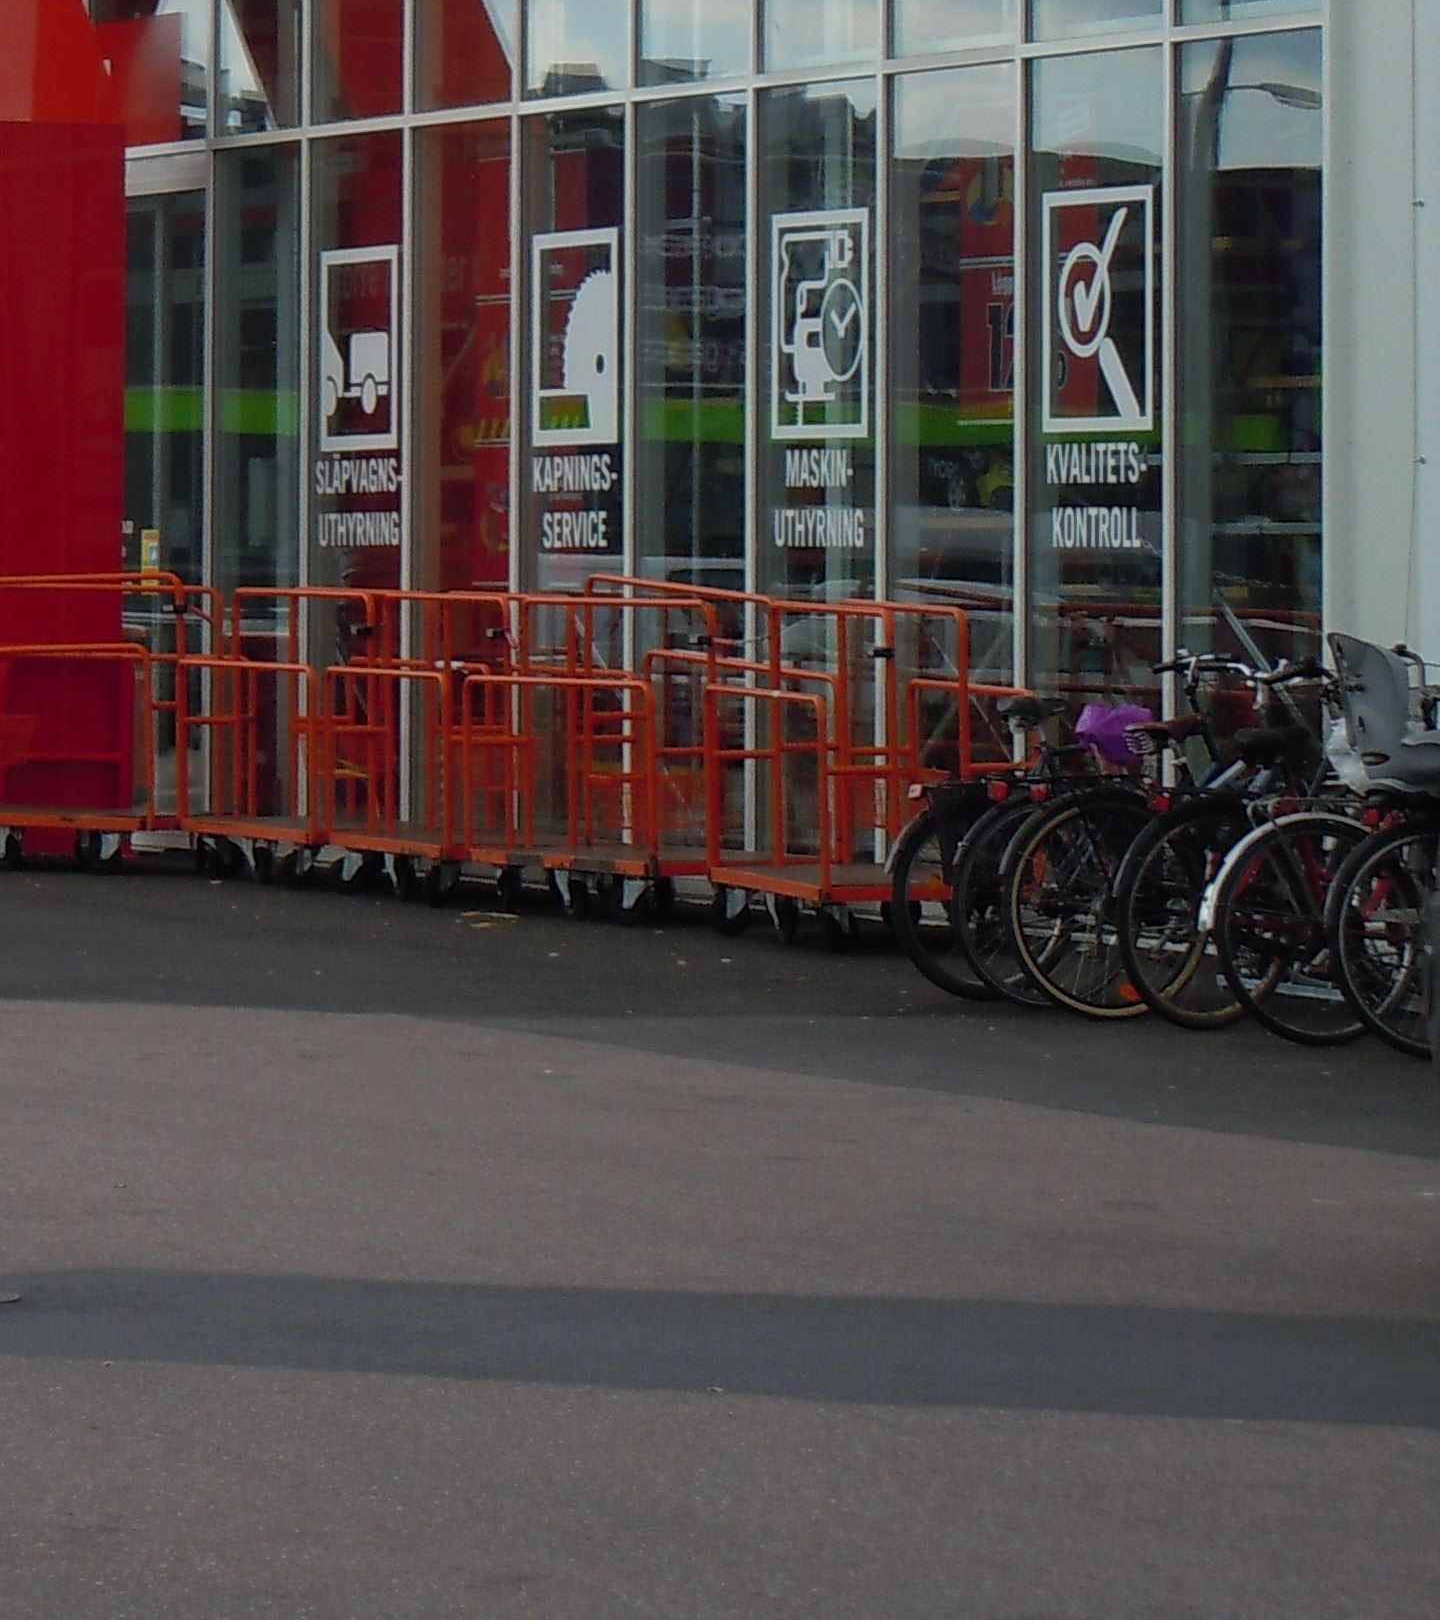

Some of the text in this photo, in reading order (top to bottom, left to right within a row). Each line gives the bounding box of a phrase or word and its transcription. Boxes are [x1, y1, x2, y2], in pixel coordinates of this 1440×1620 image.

[532, 454, 618, 493] KAPNINGS-
[785, 451, 854, 489] MASKIN-
[1046, 442, 1147, 486] KVALITETS-
[318, 511, 400, 548] UTHYRNING
[542, 507, 609, 549] SERVICE
[773, 507, 865, 549] UTHYRNING
[1051, 507, 1142, 549] KONTROLL
